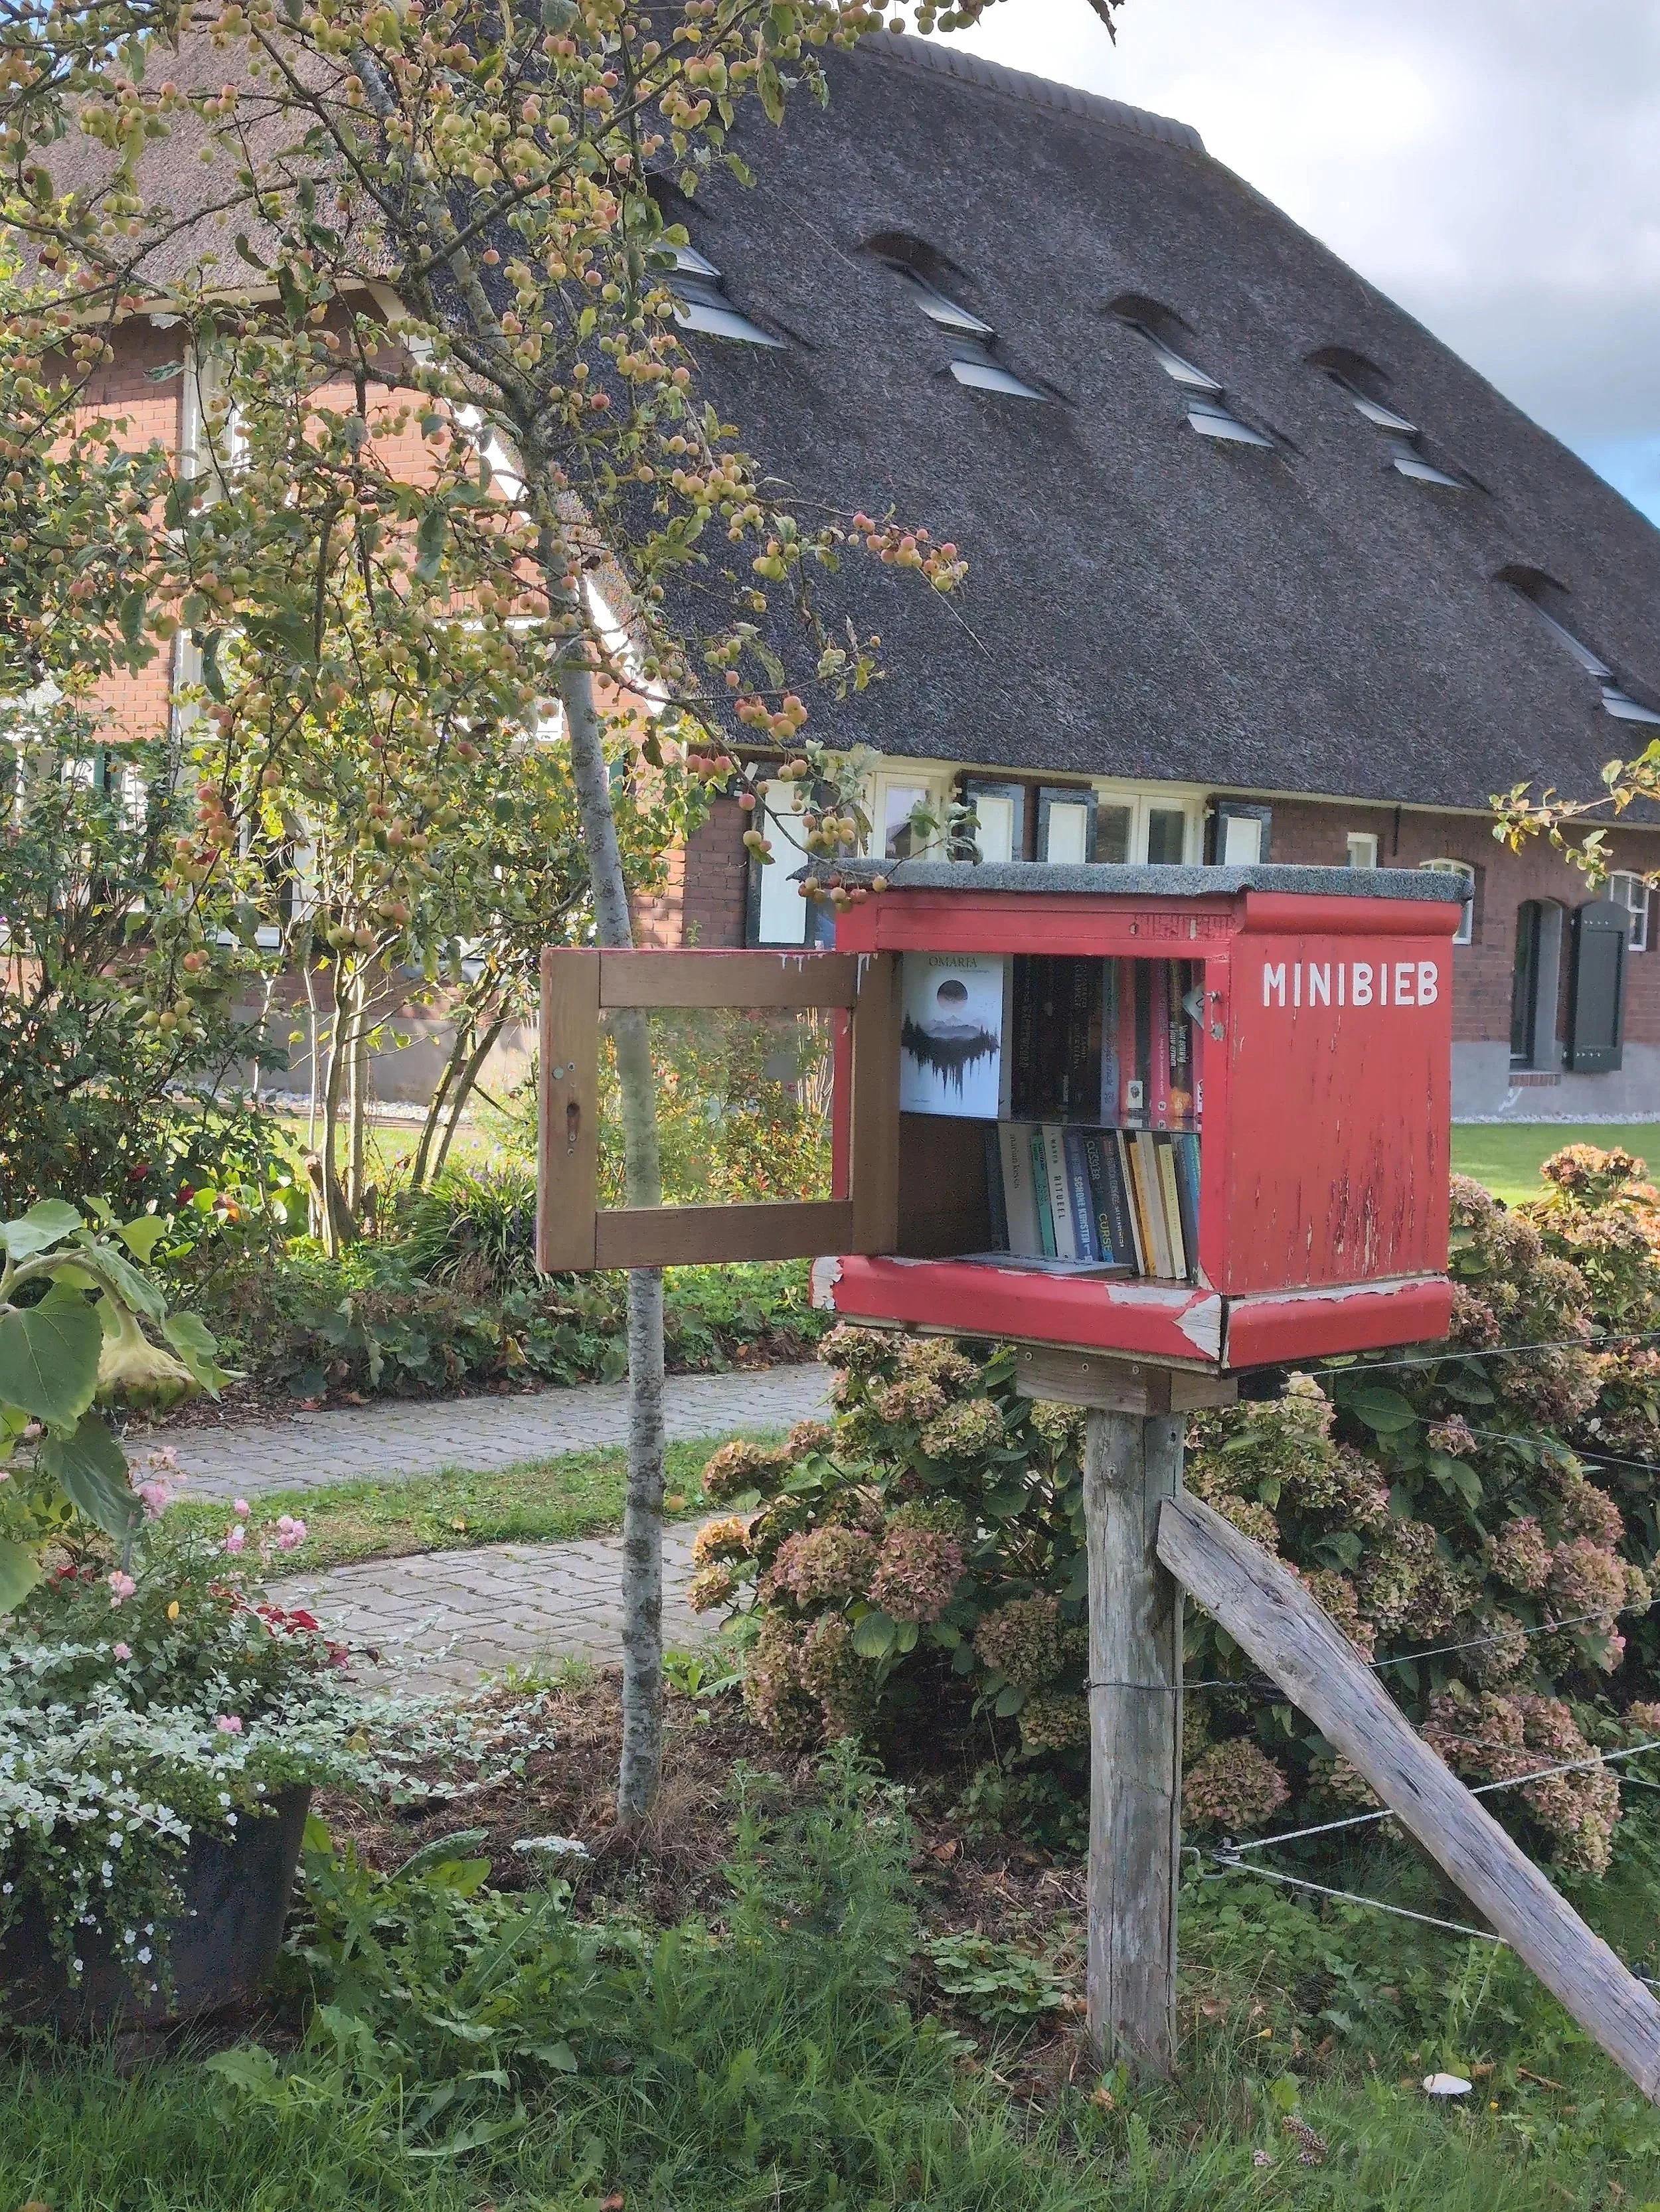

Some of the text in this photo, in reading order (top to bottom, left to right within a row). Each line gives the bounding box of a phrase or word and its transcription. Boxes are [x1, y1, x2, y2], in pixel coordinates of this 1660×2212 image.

[1264, 962, 1438, 1006] MINIBIEB
[1087, 1141, 1100, 1180] CUSSLER
[1099, 1213, 1112, 1251] CURSE
